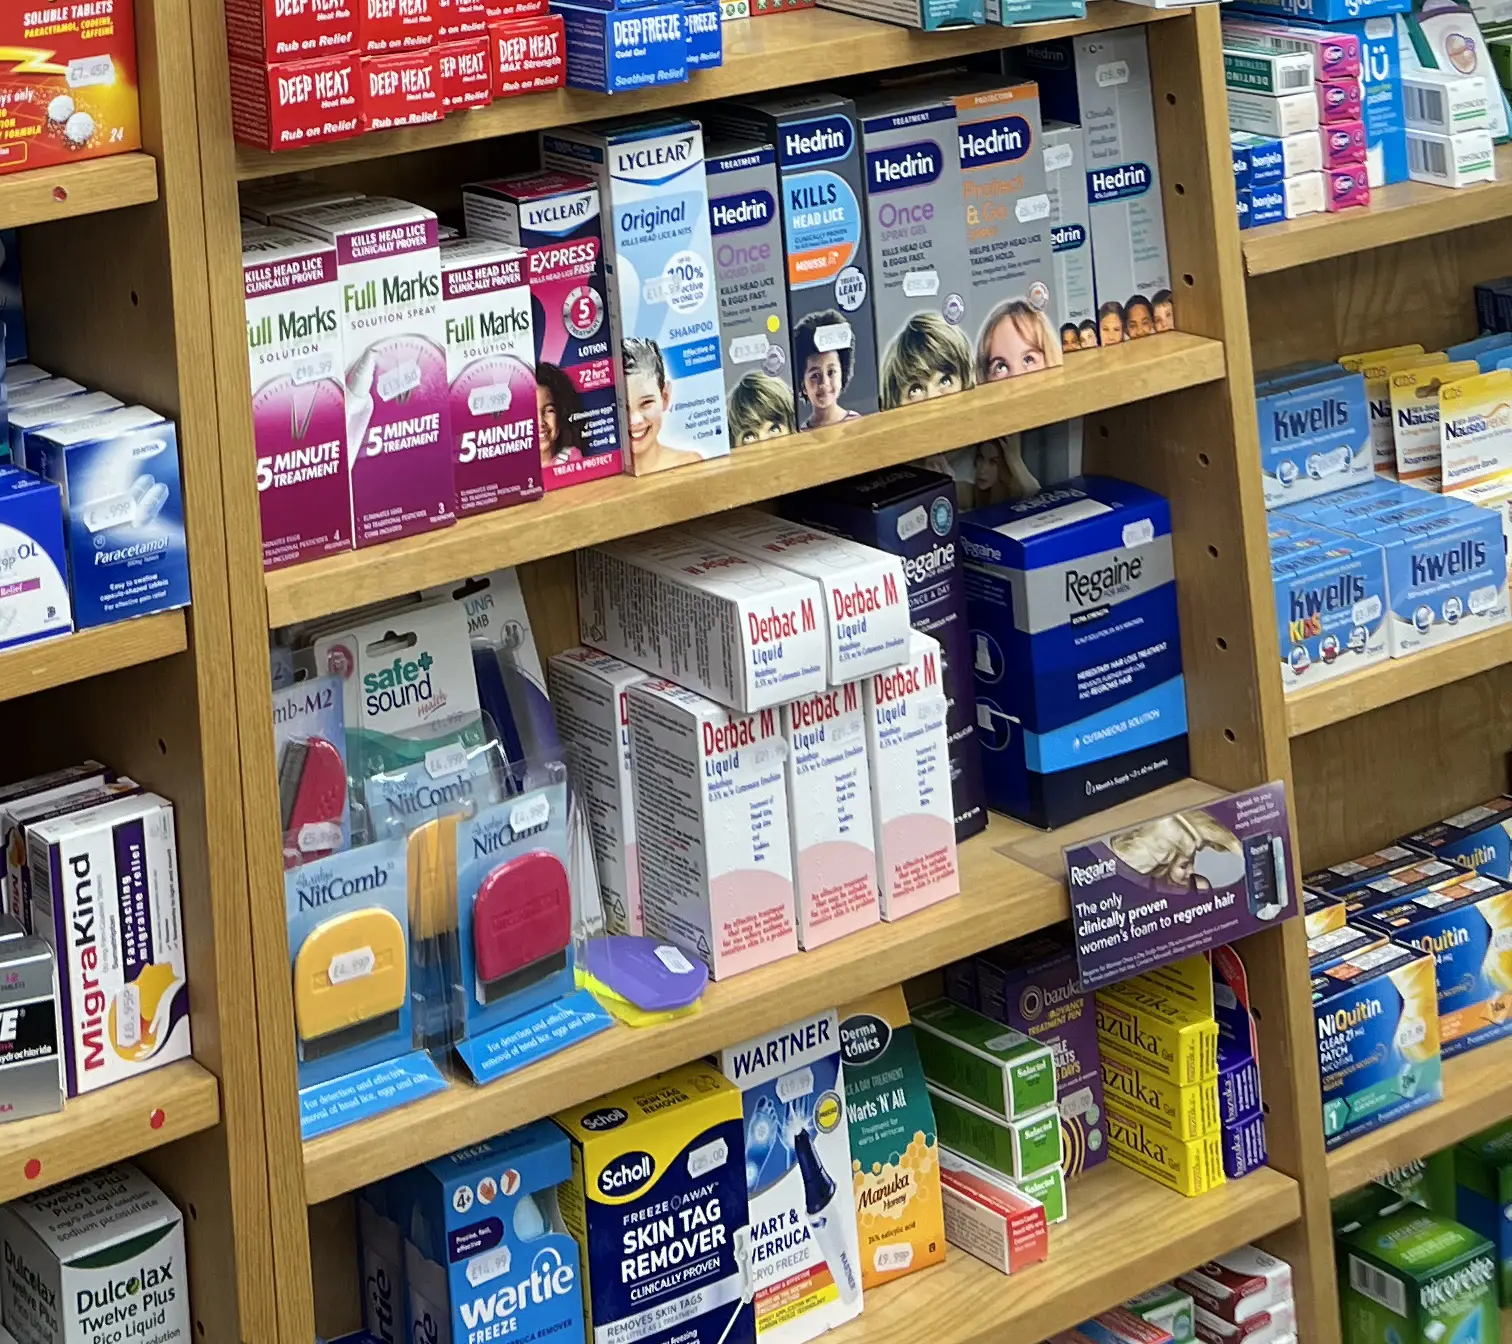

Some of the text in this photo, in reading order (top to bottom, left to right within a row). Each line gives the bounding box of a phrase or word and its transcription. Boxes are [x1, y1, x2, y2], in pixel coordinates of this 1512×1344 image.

[613, 13, 681, 48] DEEP FREEZE
[278, 67, 349, 106] DEEP HEAT
[618, 144, 686, 173] LYCLEAR
[786, 127, 845, 156] Hedrin
[959, 126, 1023, 159] Hedrin
[1252, 153, 1282, 167] bonjela
[790, 182, 837, 210] KILLS
[621, 201, 685, 233] Original
[792, 207, 843, 229] HEAD LICE
[878, 201, 935, 228] Once
[530, 243, 596, 273] EXPRESS
[344, 272, 439, 312] Full Marks
[669, 320, 713, 341] SHAMPOO
[366, 413, 440, 457] 5 MINUTE
[383, 431, 439, 454] TREATMENT
[1411, 540, 1486, 585] Kwells
[1065, 557, 1142, 606] Regaine
[748, 599, 816, 647] Derbac M
[363, 664, 419, 697] safe
[366, 683, 433, 717] sound
[706, 754, 740, 778] Liquid
[297, 866, 387, 912] NitComb
[1070, 858, 1116, 887] Regaine
[1075, 892, 1123, 919] The only
[1078, 895, 1168, 937] clinically proven
[1080, 890, 1235, 955] women's foam to regrow hair
[69, 852, 105, 1073] MigraKind
[732, 1019, 831, 1080] WARTNER
[602, 1158, 652, 1191] Scholl
[858, 1173, 909, 1211] Manuka
[622, 1201, 722, 1255] SKIN TAG
[621, 1227, 726, 1282] REMOVER
[77, 1260, 173, 1309] Dulcolax
[461, 1258, 574, 1330] wartie
[79, 1285, 175, 1334] Twelve Plus
